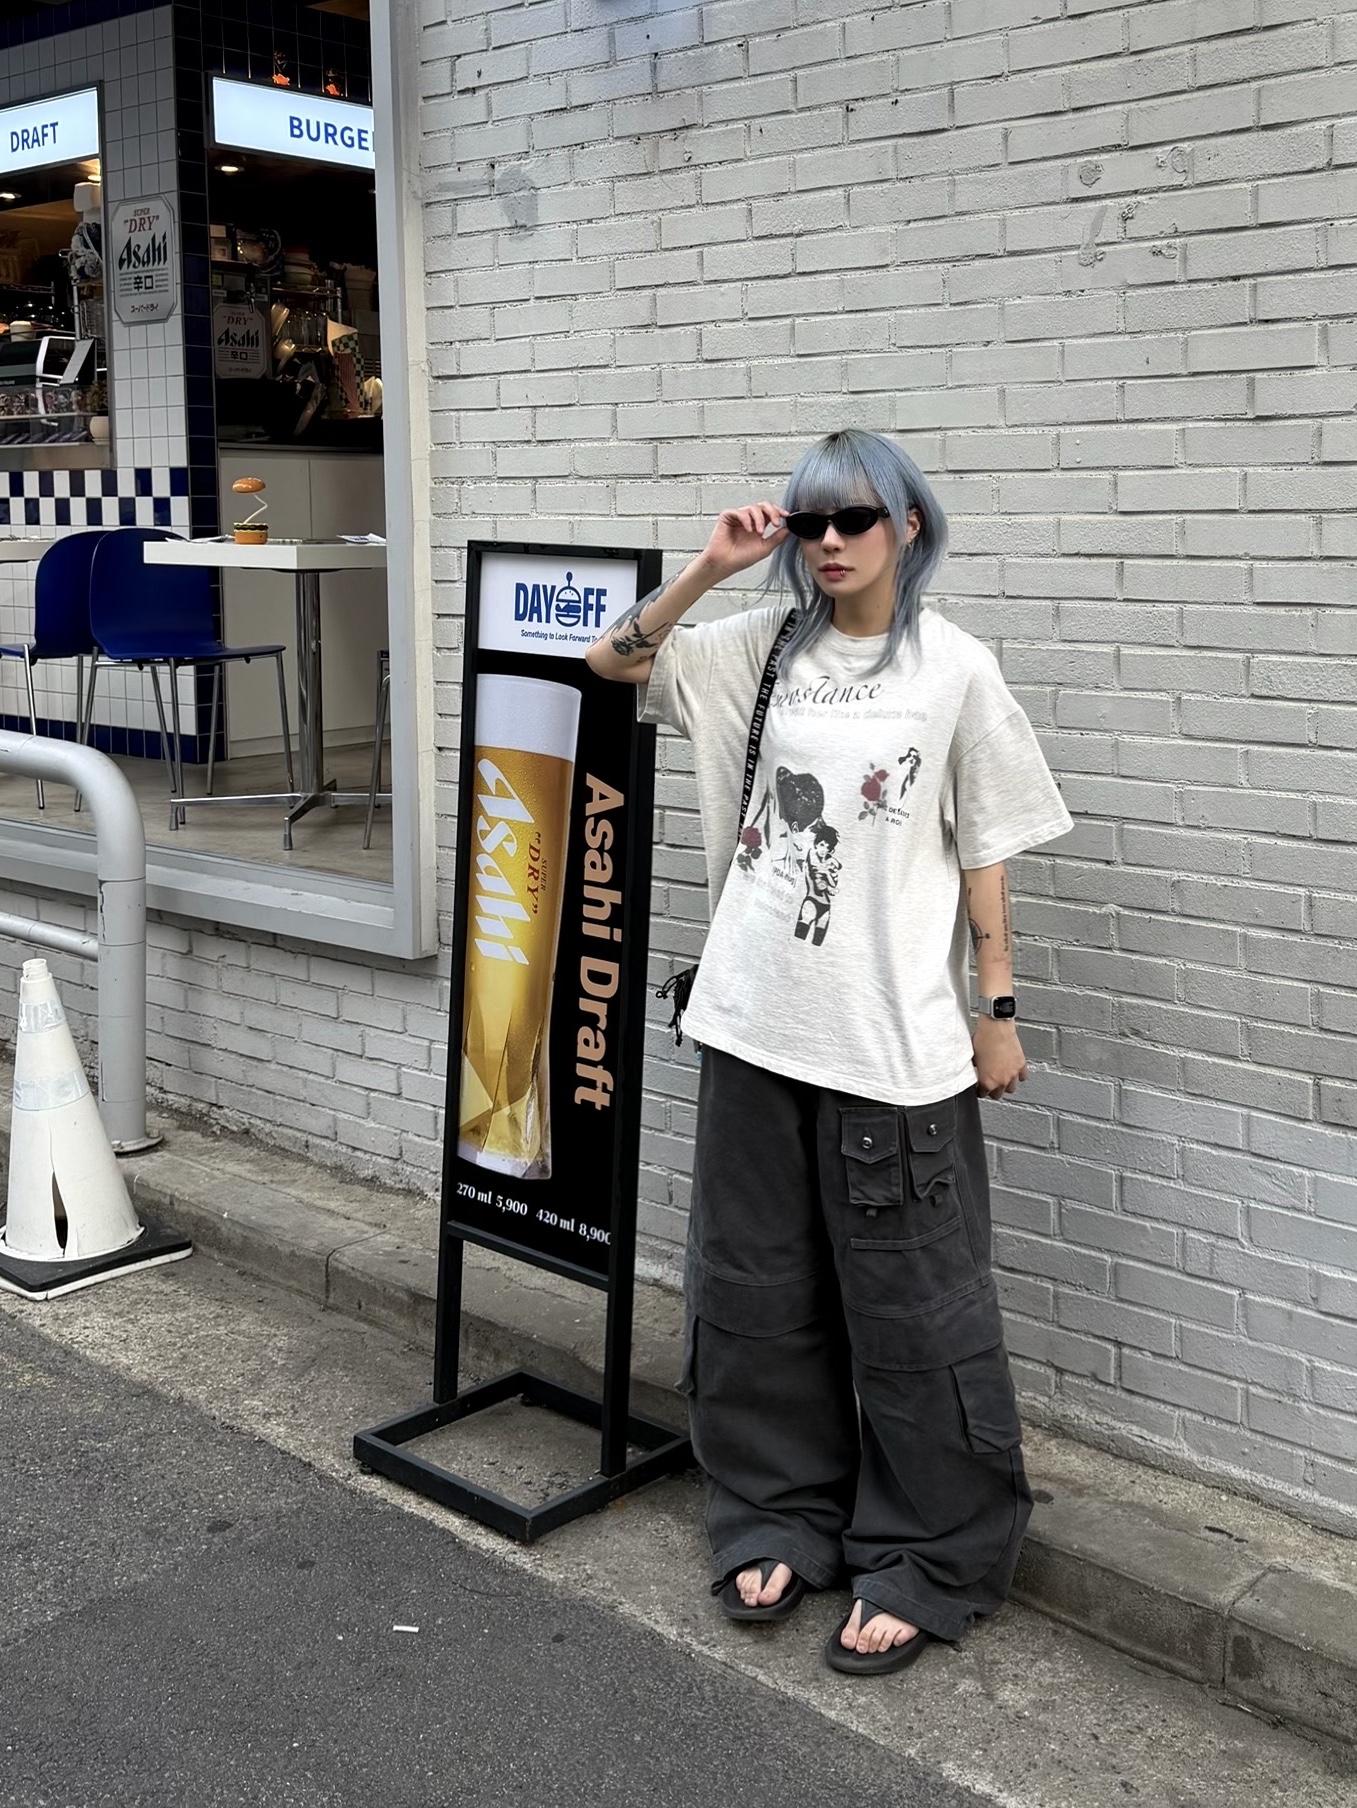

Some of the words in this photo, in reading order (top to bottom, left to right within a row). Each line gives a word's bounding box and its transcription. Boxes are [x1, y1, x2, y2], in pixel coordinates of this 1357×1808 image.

[10, 121, 59, 153] DRAFT
[289, 115, 373, 152] BURGE
[118, 230, 168, 271] Asahi
[133, 275, 154, 292] 辛口
[217, 327, 260, 348] Asahi
[521, 629, 548, 641] Something
[549, 632, 555, 640] to
[555, 632, 568, 641] Look
[569, 633, 591, 643] Forward
[758, 682, 772, 700] THE
[752, 702, 767, 742] FUTURE
[746, 758, 755, 771] IN
[749, 744, 757, 756] IS
[743, 774, 754, 792] THE
[475, 758, 535, 966] Asahi
[582, 773, 625, 943] Asahi
[574, 956, 620, 1110] Draft
[456, 1182, 476, 1199] 270
[477, 1191, 492, 1204] ml
[495, 1195, 528, 1216] 5,900
[535, 1209, 558, 1226] 420
[559, 1218, 575, 1232] ml
